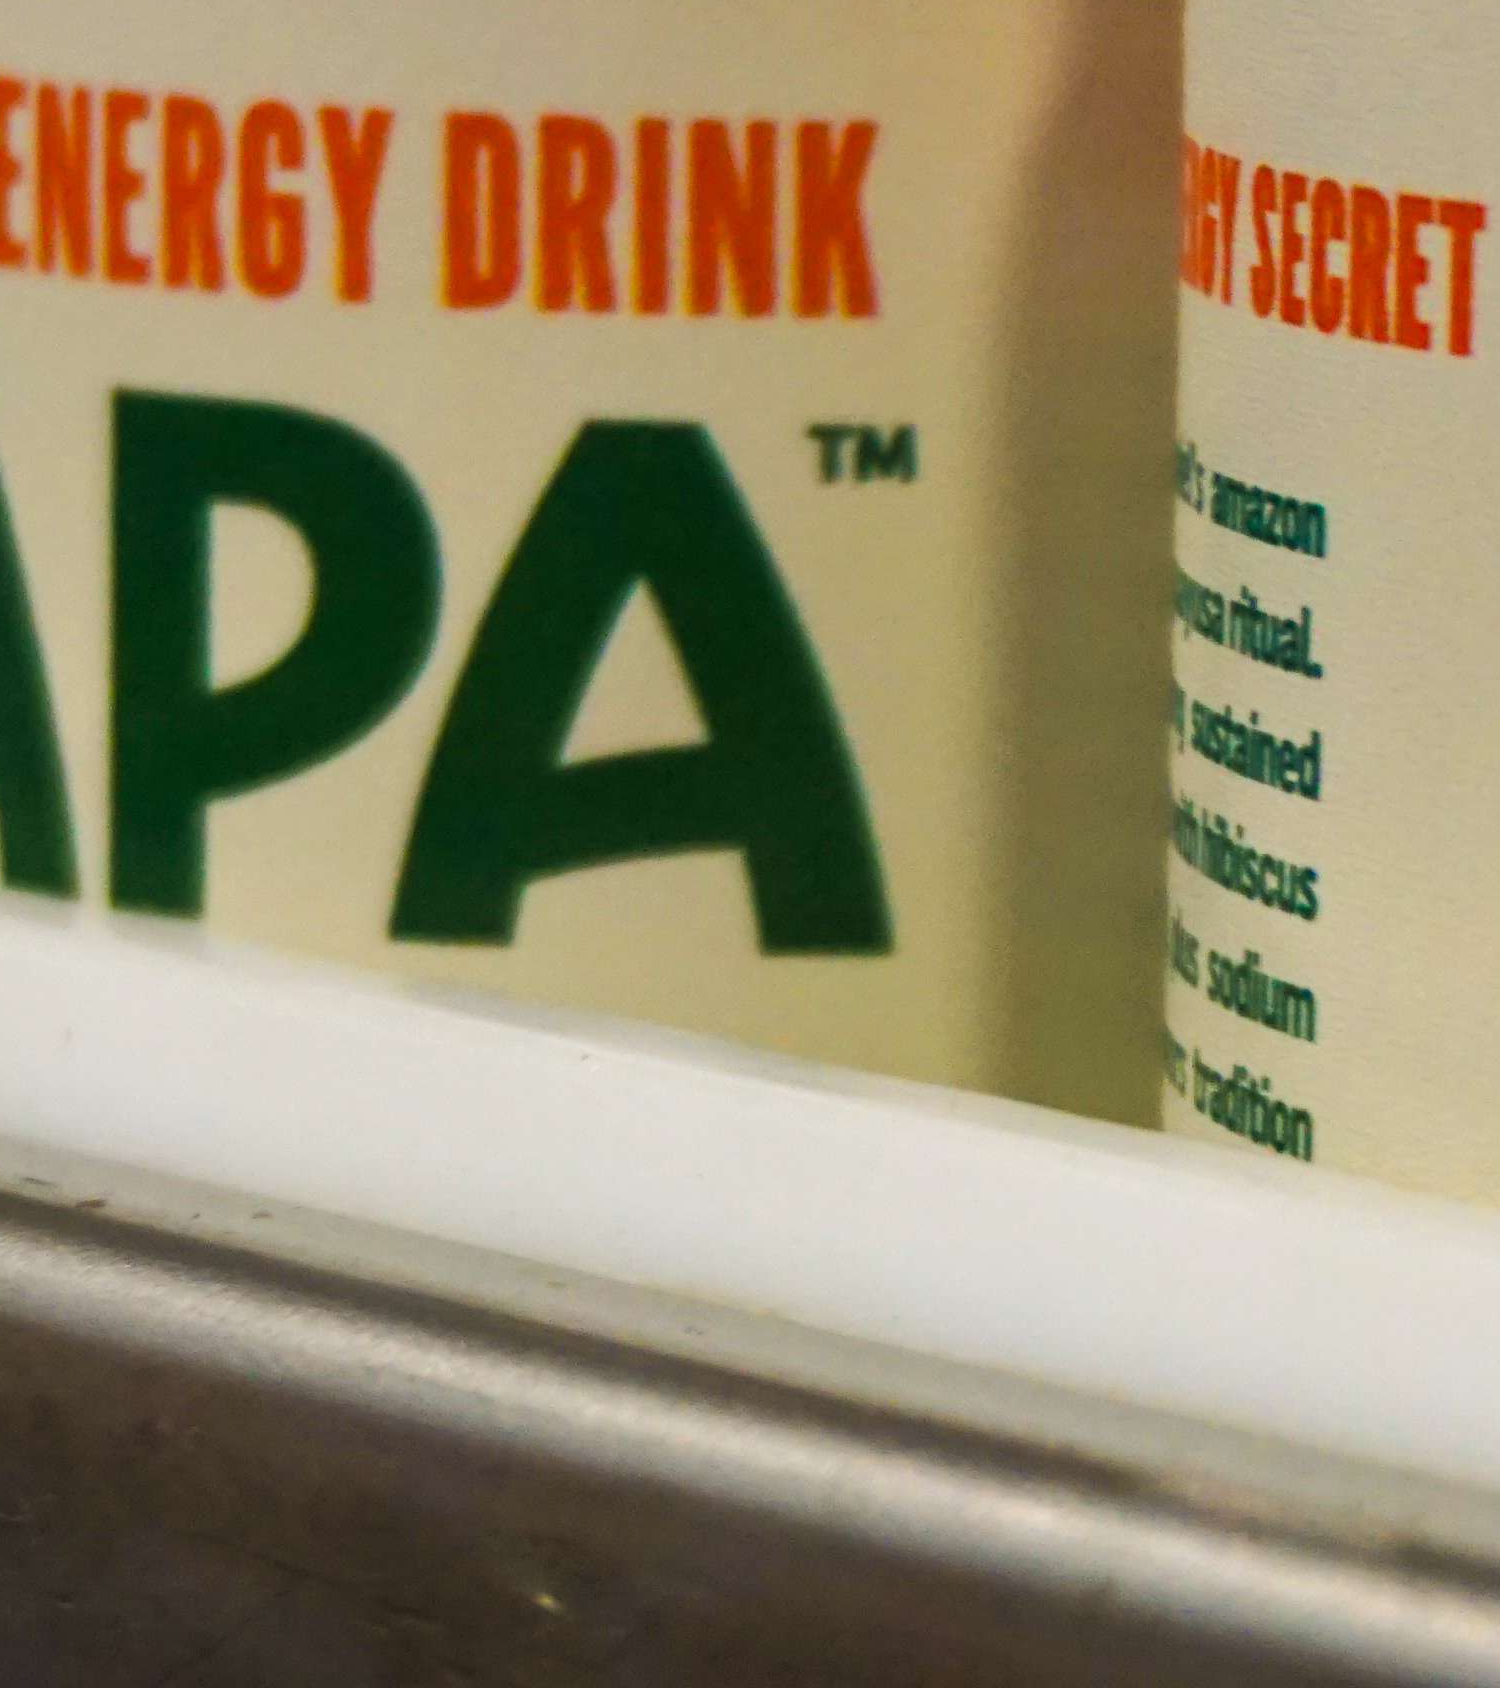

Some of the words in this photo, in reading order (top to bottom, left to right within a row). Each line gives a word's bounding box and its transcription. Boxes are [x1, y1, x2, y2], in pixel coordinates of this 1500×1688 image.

[442, 111, 880, 320] DRINK
[1251, 162, 1487, 358] SECRET
[1210, 472, 1328, 559] amazon
[1191, 698, 1321, 801] sustained
[1201, 806, 1319, 922] hibiscus
[1207, 947, 1318, 1044] sodium
[1191, 1047, 1314, 1163] tradition
